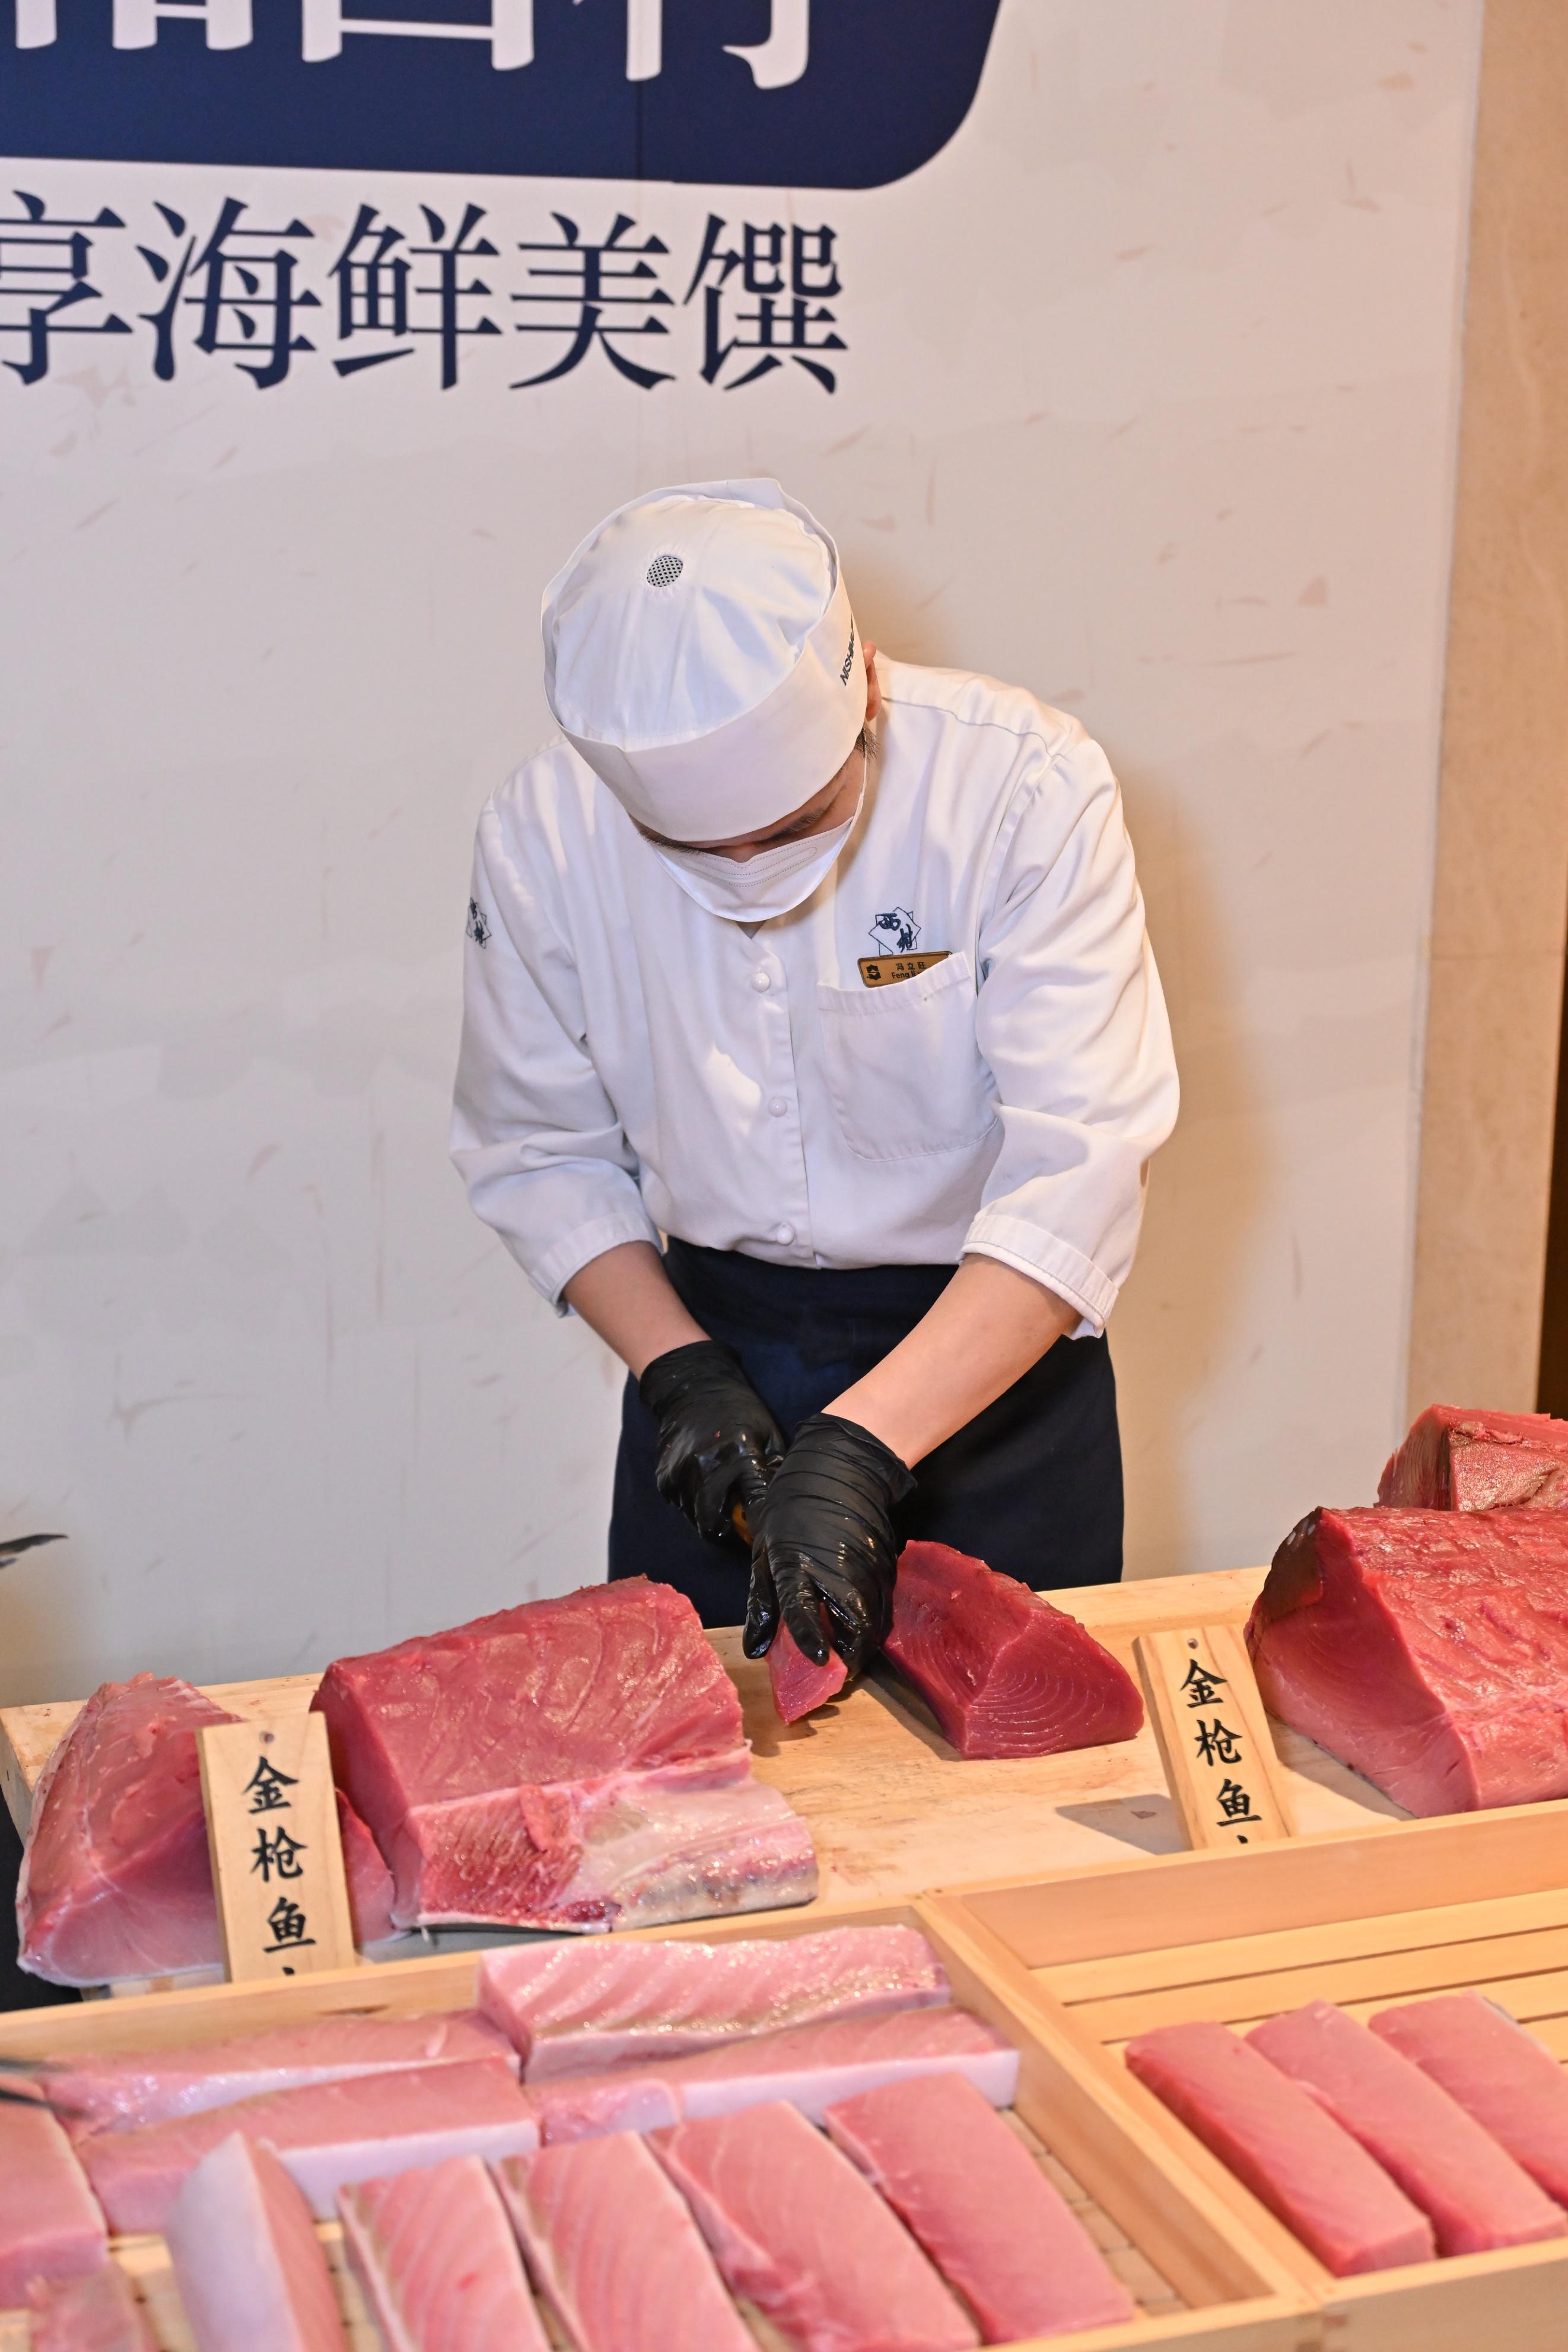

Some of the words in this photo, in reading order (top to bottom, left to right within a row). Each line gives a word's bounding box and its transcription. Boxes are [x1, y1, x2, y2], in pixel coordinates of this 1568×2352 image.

[1179, 1658, 1262, 1844] 金枪鱼
[241, 1756, 316, 1975] 金枪鱼
